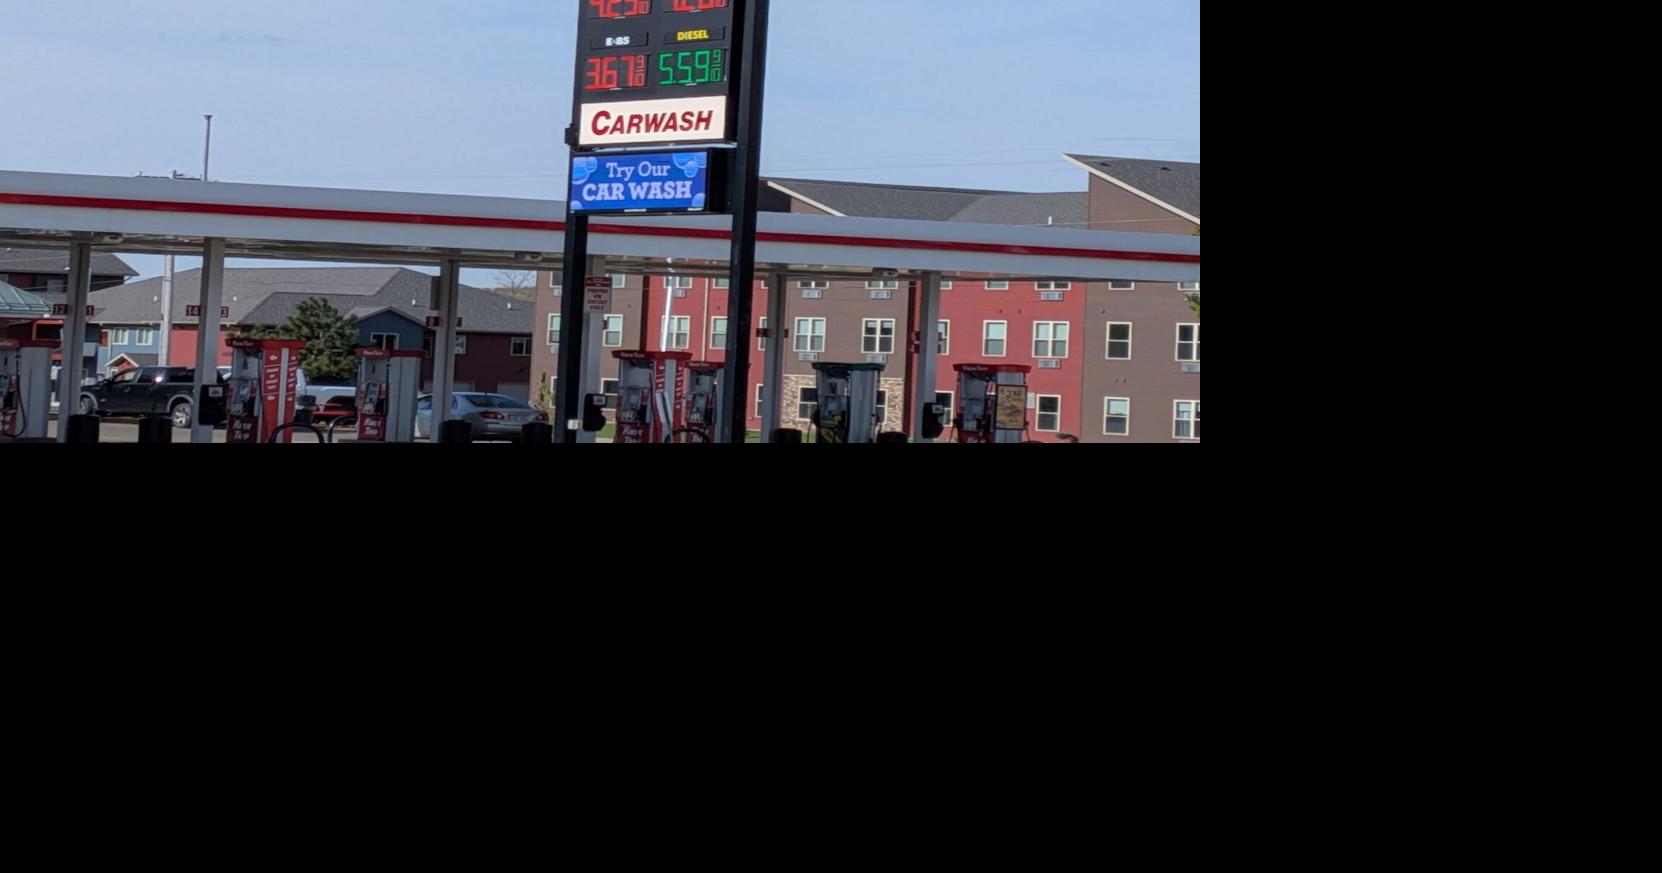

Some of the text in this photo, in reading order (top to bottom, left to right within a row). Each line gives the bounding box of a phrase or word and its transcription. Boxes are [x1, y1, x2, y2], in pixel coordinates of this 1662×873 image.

[605, 36, 630, 46] E-85
[677, 29, 709, 41] DIESEL
[591, 110, 713, 136] CARWASH
[606, 161, 671, 181] Try Our
[582, 180, 693, 201] CAR WASH
